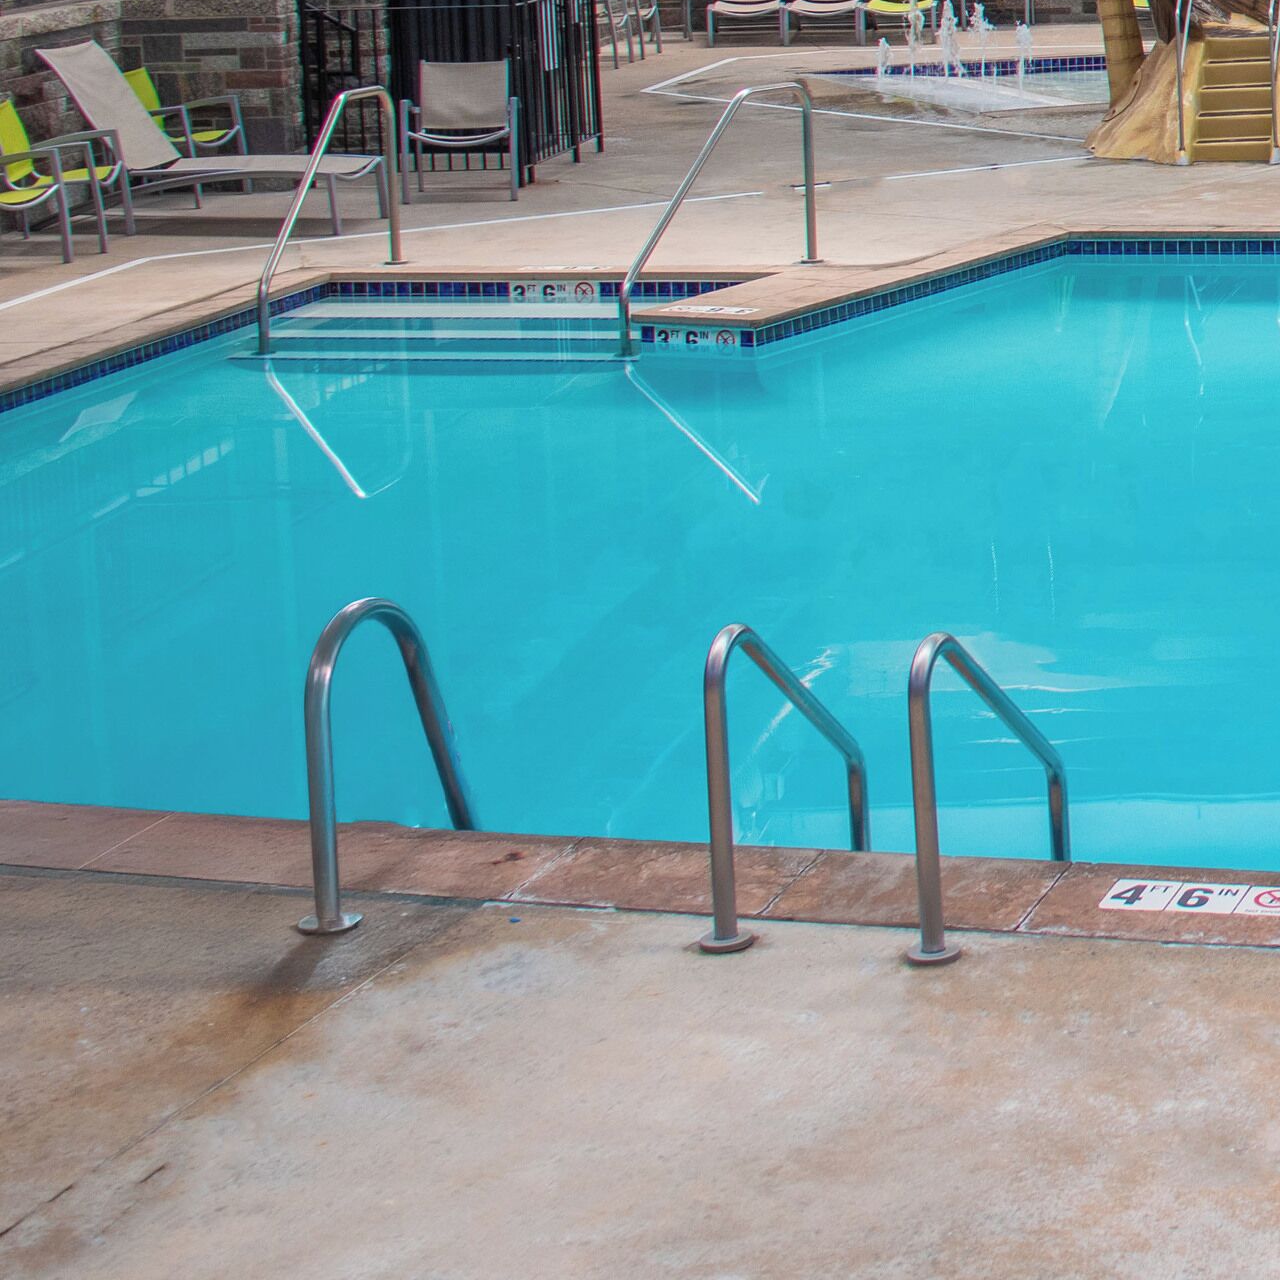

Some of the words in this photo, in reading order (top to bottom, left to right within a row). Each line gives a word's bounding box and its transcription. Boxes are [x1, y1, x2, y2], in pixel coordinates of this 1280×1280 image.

[527, 284, 536, 292] FT
[543, 284, 555, 296] 6
[556, 284, 566, 292] IN
[671, 330, 680, 339] FT
[685, 330, 699, 344] 6
[700, 331, 709, 339] IN
[1110, 884, 1148, 905] 4
[1149, 885, 1171, 894] FT
[1177, 887, 1214, 908] 6
[1218, 888, 1240, 897] IN
